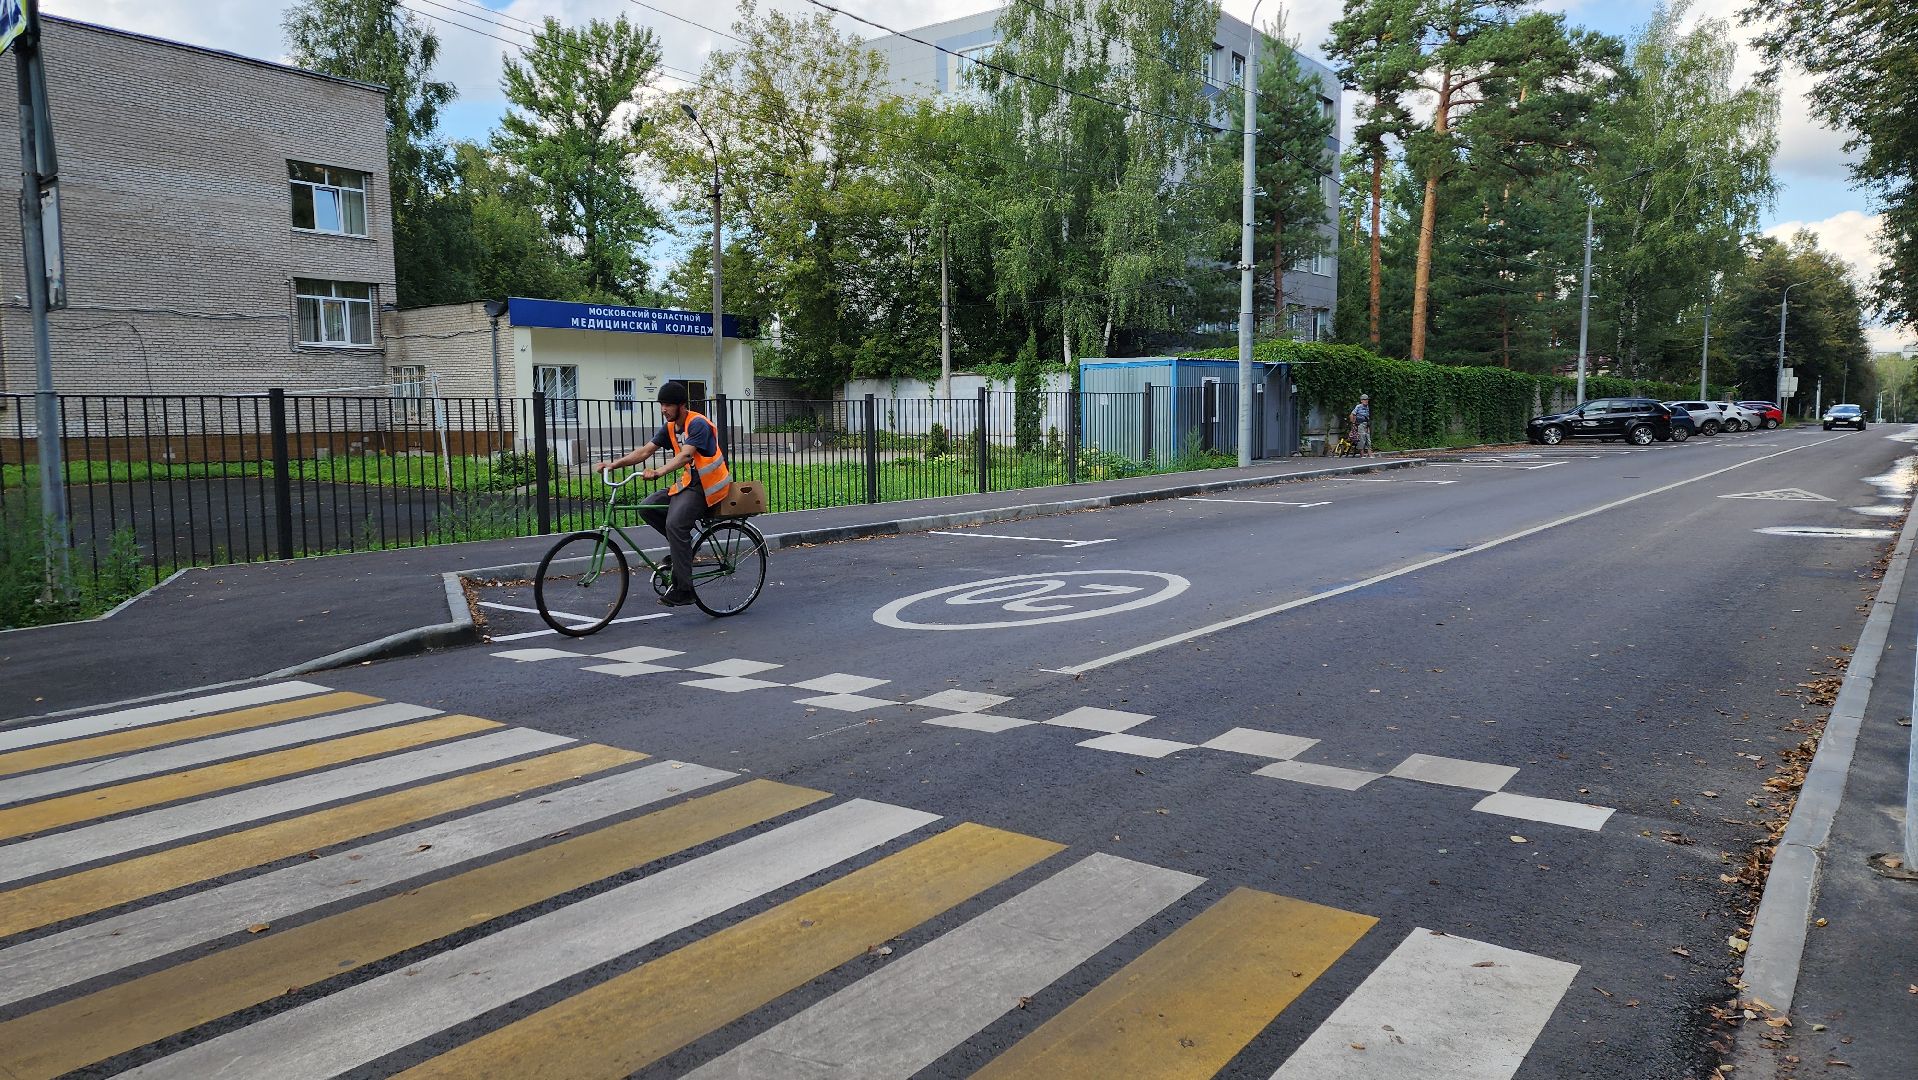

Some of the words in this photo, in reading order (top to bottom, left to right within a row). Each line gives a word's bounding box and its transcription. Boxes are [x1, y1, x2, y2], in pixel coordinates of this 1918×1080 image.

[588, 307, 650, 319] МОСКОВСКИЙ
[651, 312, 701, 322] ОБЛАСТНОЙ
[571, 317, 658, 331] МЕДИЦИНСКИЙ
[945, 579, 1145, 612] 20
